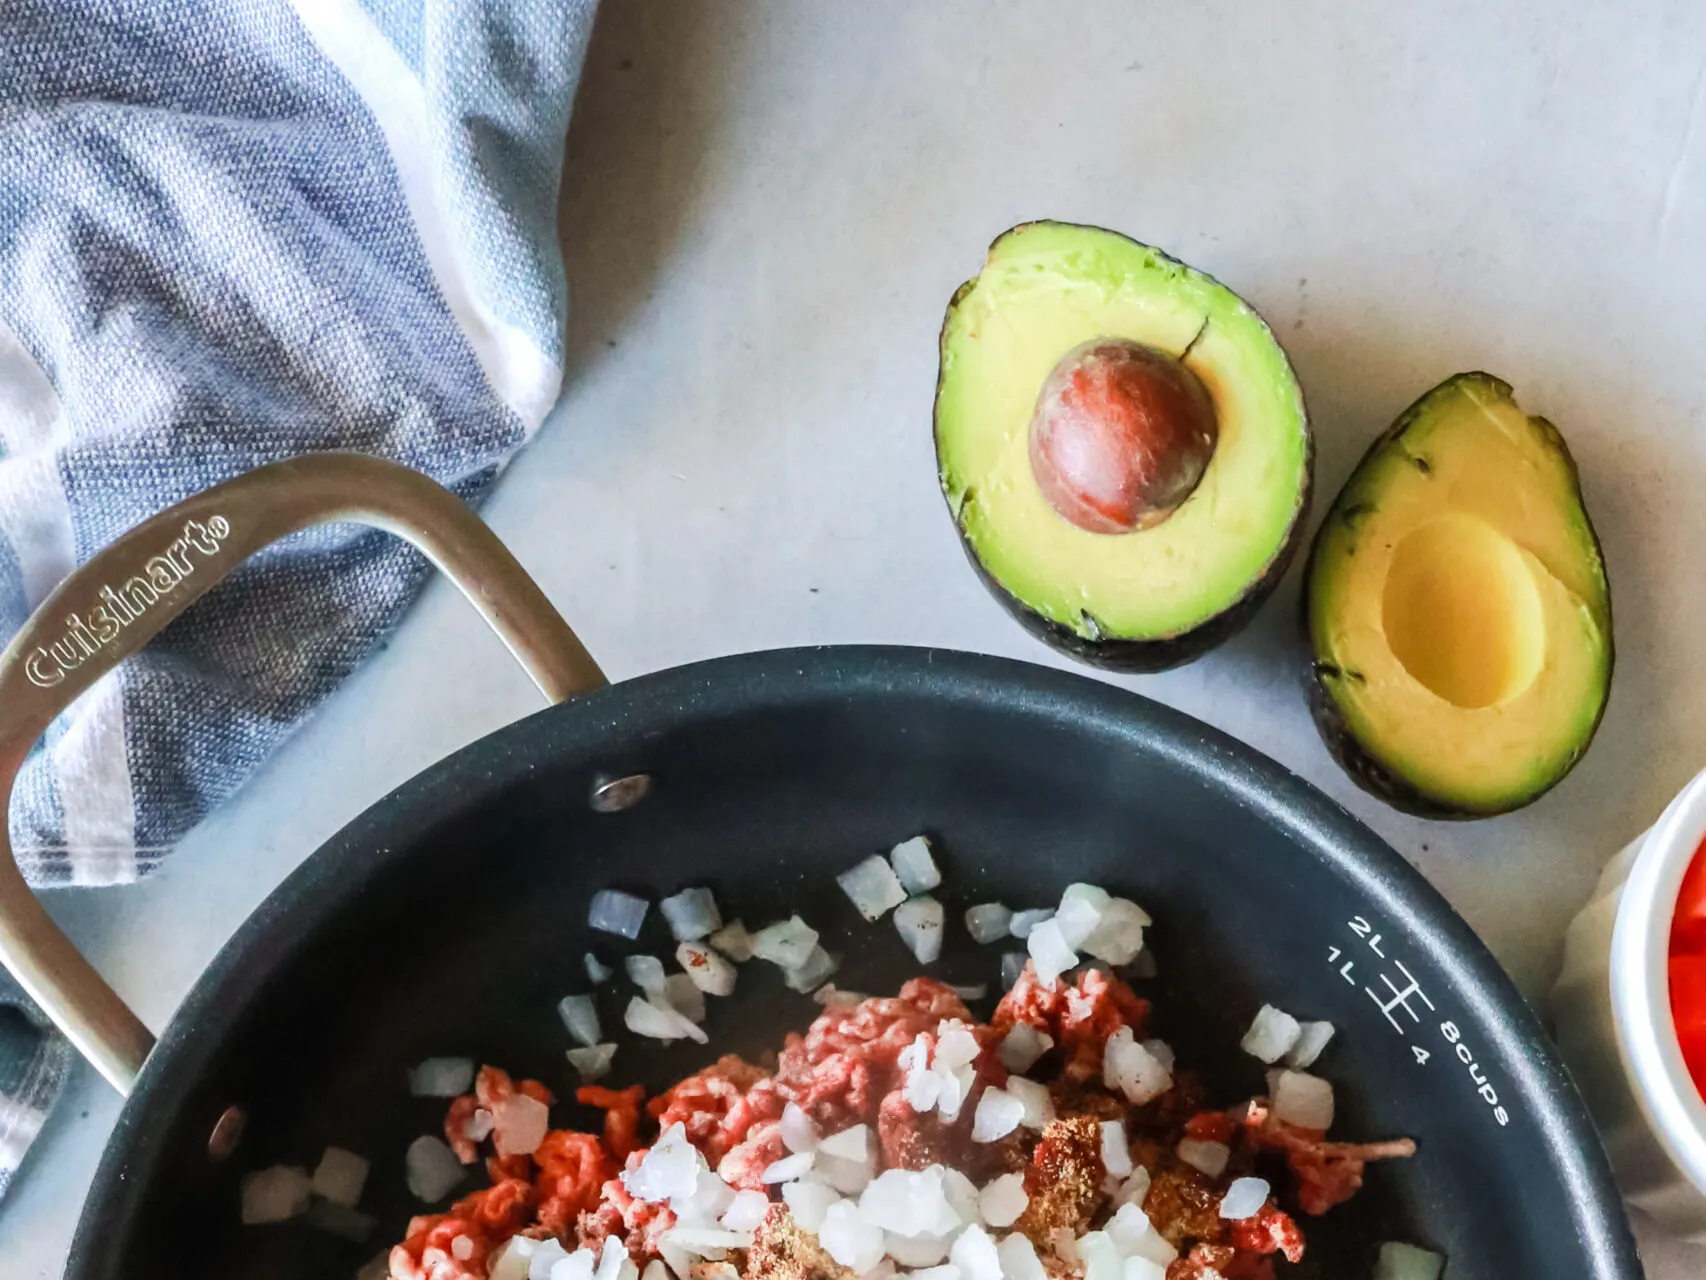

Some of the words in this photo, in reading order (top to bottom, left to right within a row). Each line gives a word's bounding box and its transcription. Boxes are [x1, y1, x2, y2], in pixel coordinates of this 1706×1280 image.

[1348, 915, 1385, 959] 2L
[1327, 945, 1356, 986] 1L
[1411, 1045, 1431, 1066] 4
